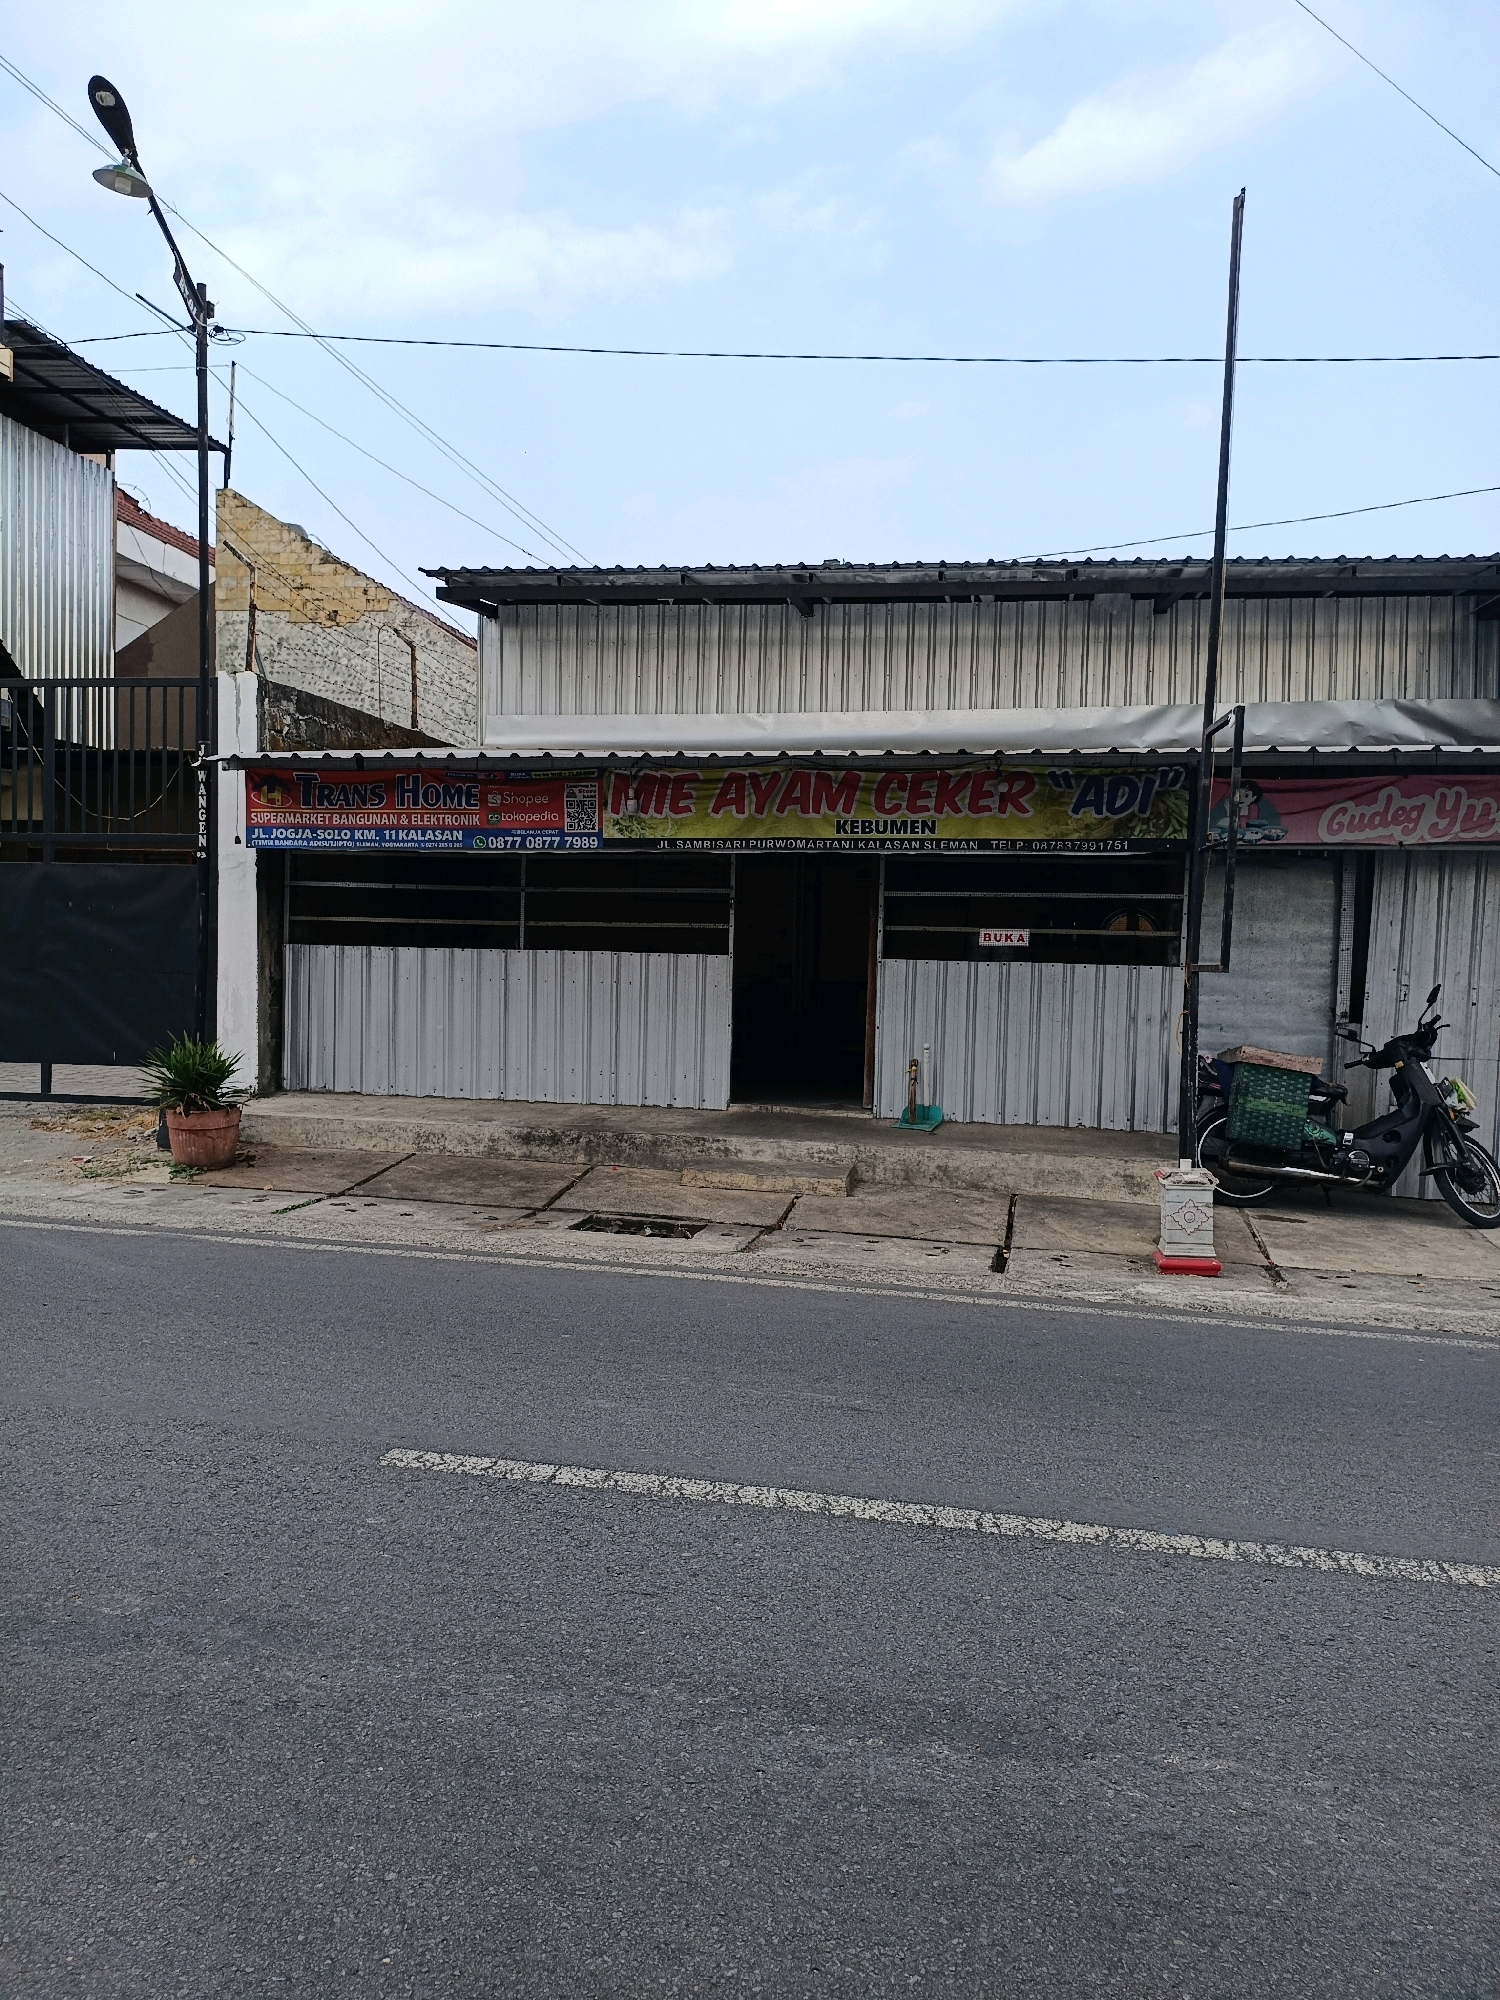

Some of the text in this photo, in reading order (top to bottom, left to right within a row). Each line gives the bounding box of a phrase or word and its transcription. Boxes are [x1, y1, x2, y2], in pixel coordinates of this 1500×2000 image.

[293, 772, 480, 809] TRANS HOME
[608, 771, 702, 818] MIE
[709, 771, 864, 818] AYAM
[873, 770, 1038, 818] CEKER
[502, 792, 549, 807] Shopee
[198, 771, 207, 847] WANGEN
[1326, 793, 1426, 837] Gudeg
[250, 812, 480, 826] SUPERMARKET BANGUNAN & ELEKTRONIK
[501, 811, 559, 823] tokopedia
[834, 819, 937, 835] KEBUMEN
[251, 828, 463, 841] JL. JOGJA-SOLO KM. 11 KALASAN
[274, 839, 308, 847] BANDARA
[488, 836, 598, 849] 0877 0877 7989
[749, 839, 854, 849] PURWOMARTANI
[858, 840, 920, 849] KALASAN
[923, 840, 978, 850] SLEMAN
[1032, 840, 1129, 850] 087837991751
[983, 933, 1025, 942] BUKA
